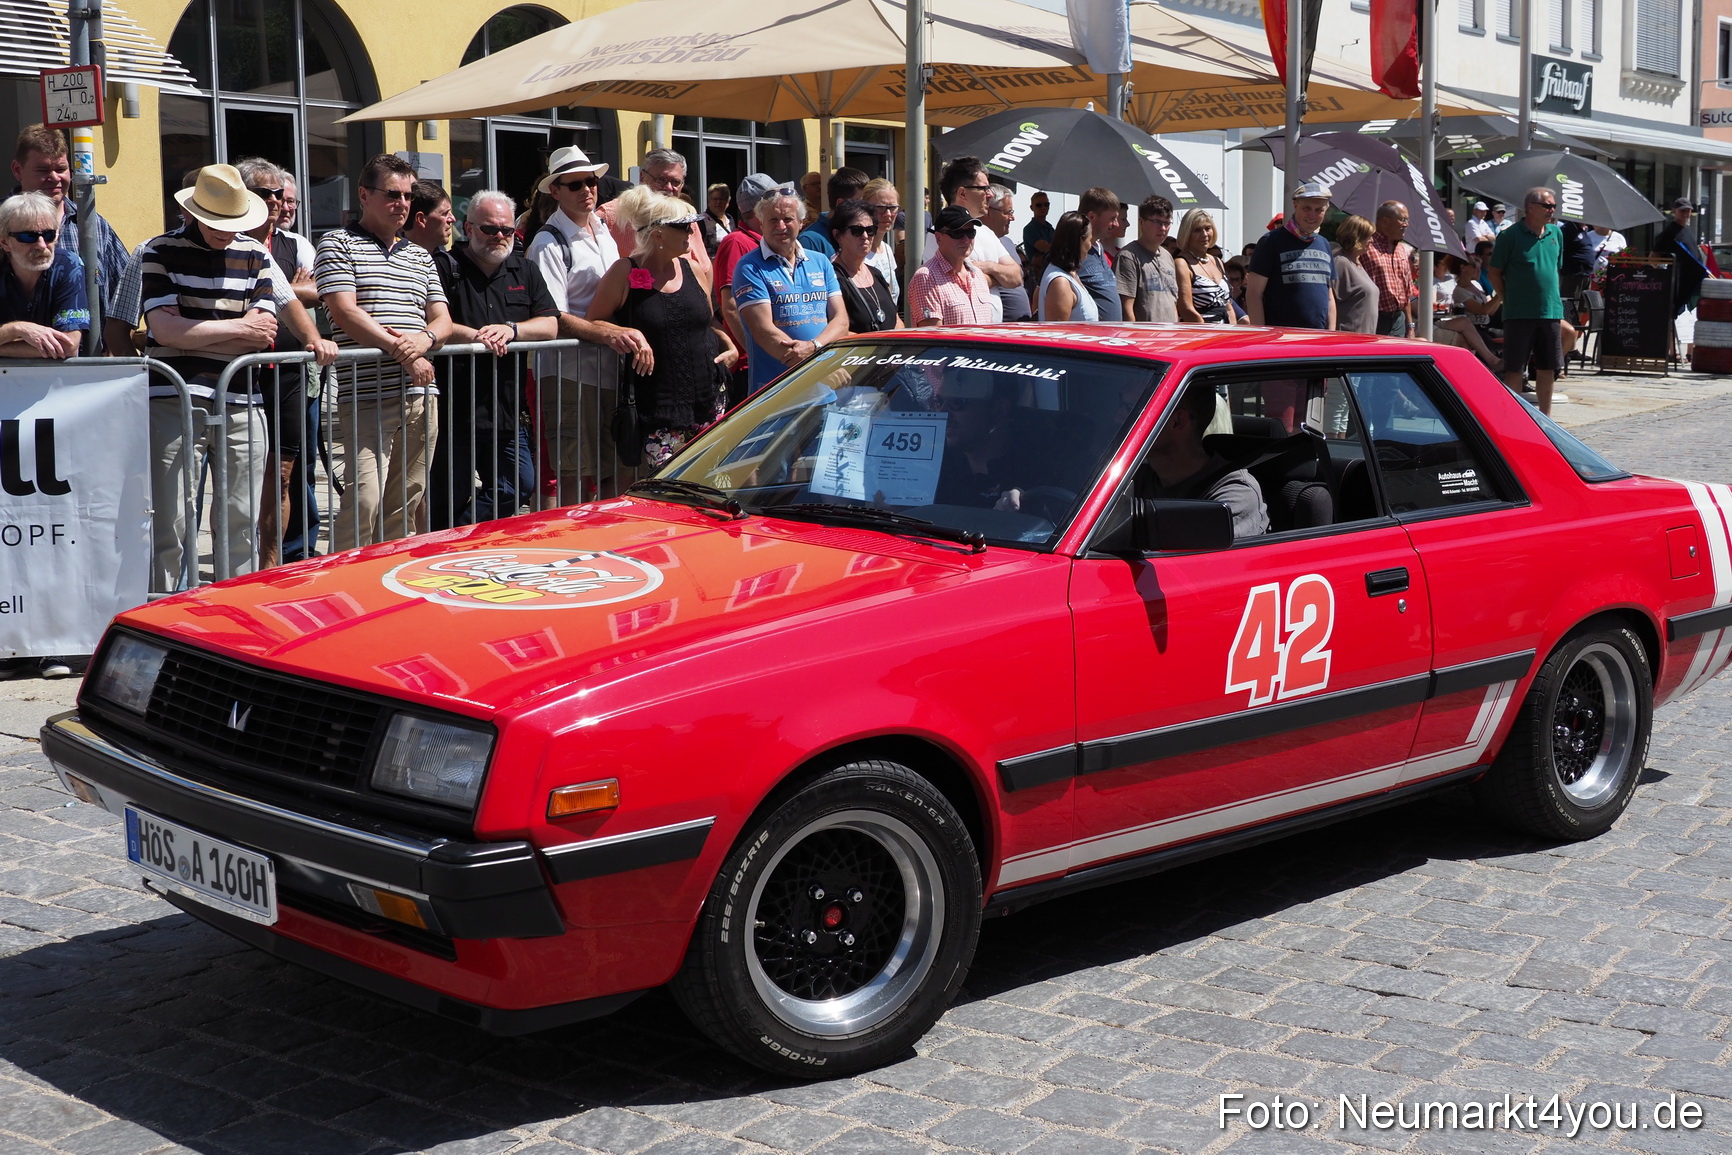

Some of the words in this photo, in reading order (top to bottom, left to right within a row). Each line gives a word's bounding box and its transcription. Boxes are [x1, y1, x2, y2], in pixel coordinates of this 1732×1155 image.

[580, 32, 741, 59] Neumarkter
[522, 45, 751, 85] Lammsbräu
[47, 75, 55, 88] H
[63, 73, 83, 87] 200
[989, 127, 1049, 169] now
[1138, 148, 1194, 198] now
[1463, 155, 1510, 176] now
[1562, 178, 1584, 216] now
[1286, 250, 1328, 259] HILFIGER
[1287, 262, 1320, 270] DENIM
[841, 356, 876, 367] Old
[876, 354, 948, 367] School
[947, 356, 1067, 381] Mitsubishi
[881, 431, 922, 452] 459
[403, 575, 546, 604] 600
[1224, 573, 1335, 708] 42
[192, 840, 205, 885] A
[209, 847, 268, 908] 160H
[721, 830, 769, 943] 225/50ZR15
[760, 1035, 827, 1066] FK-05GR
